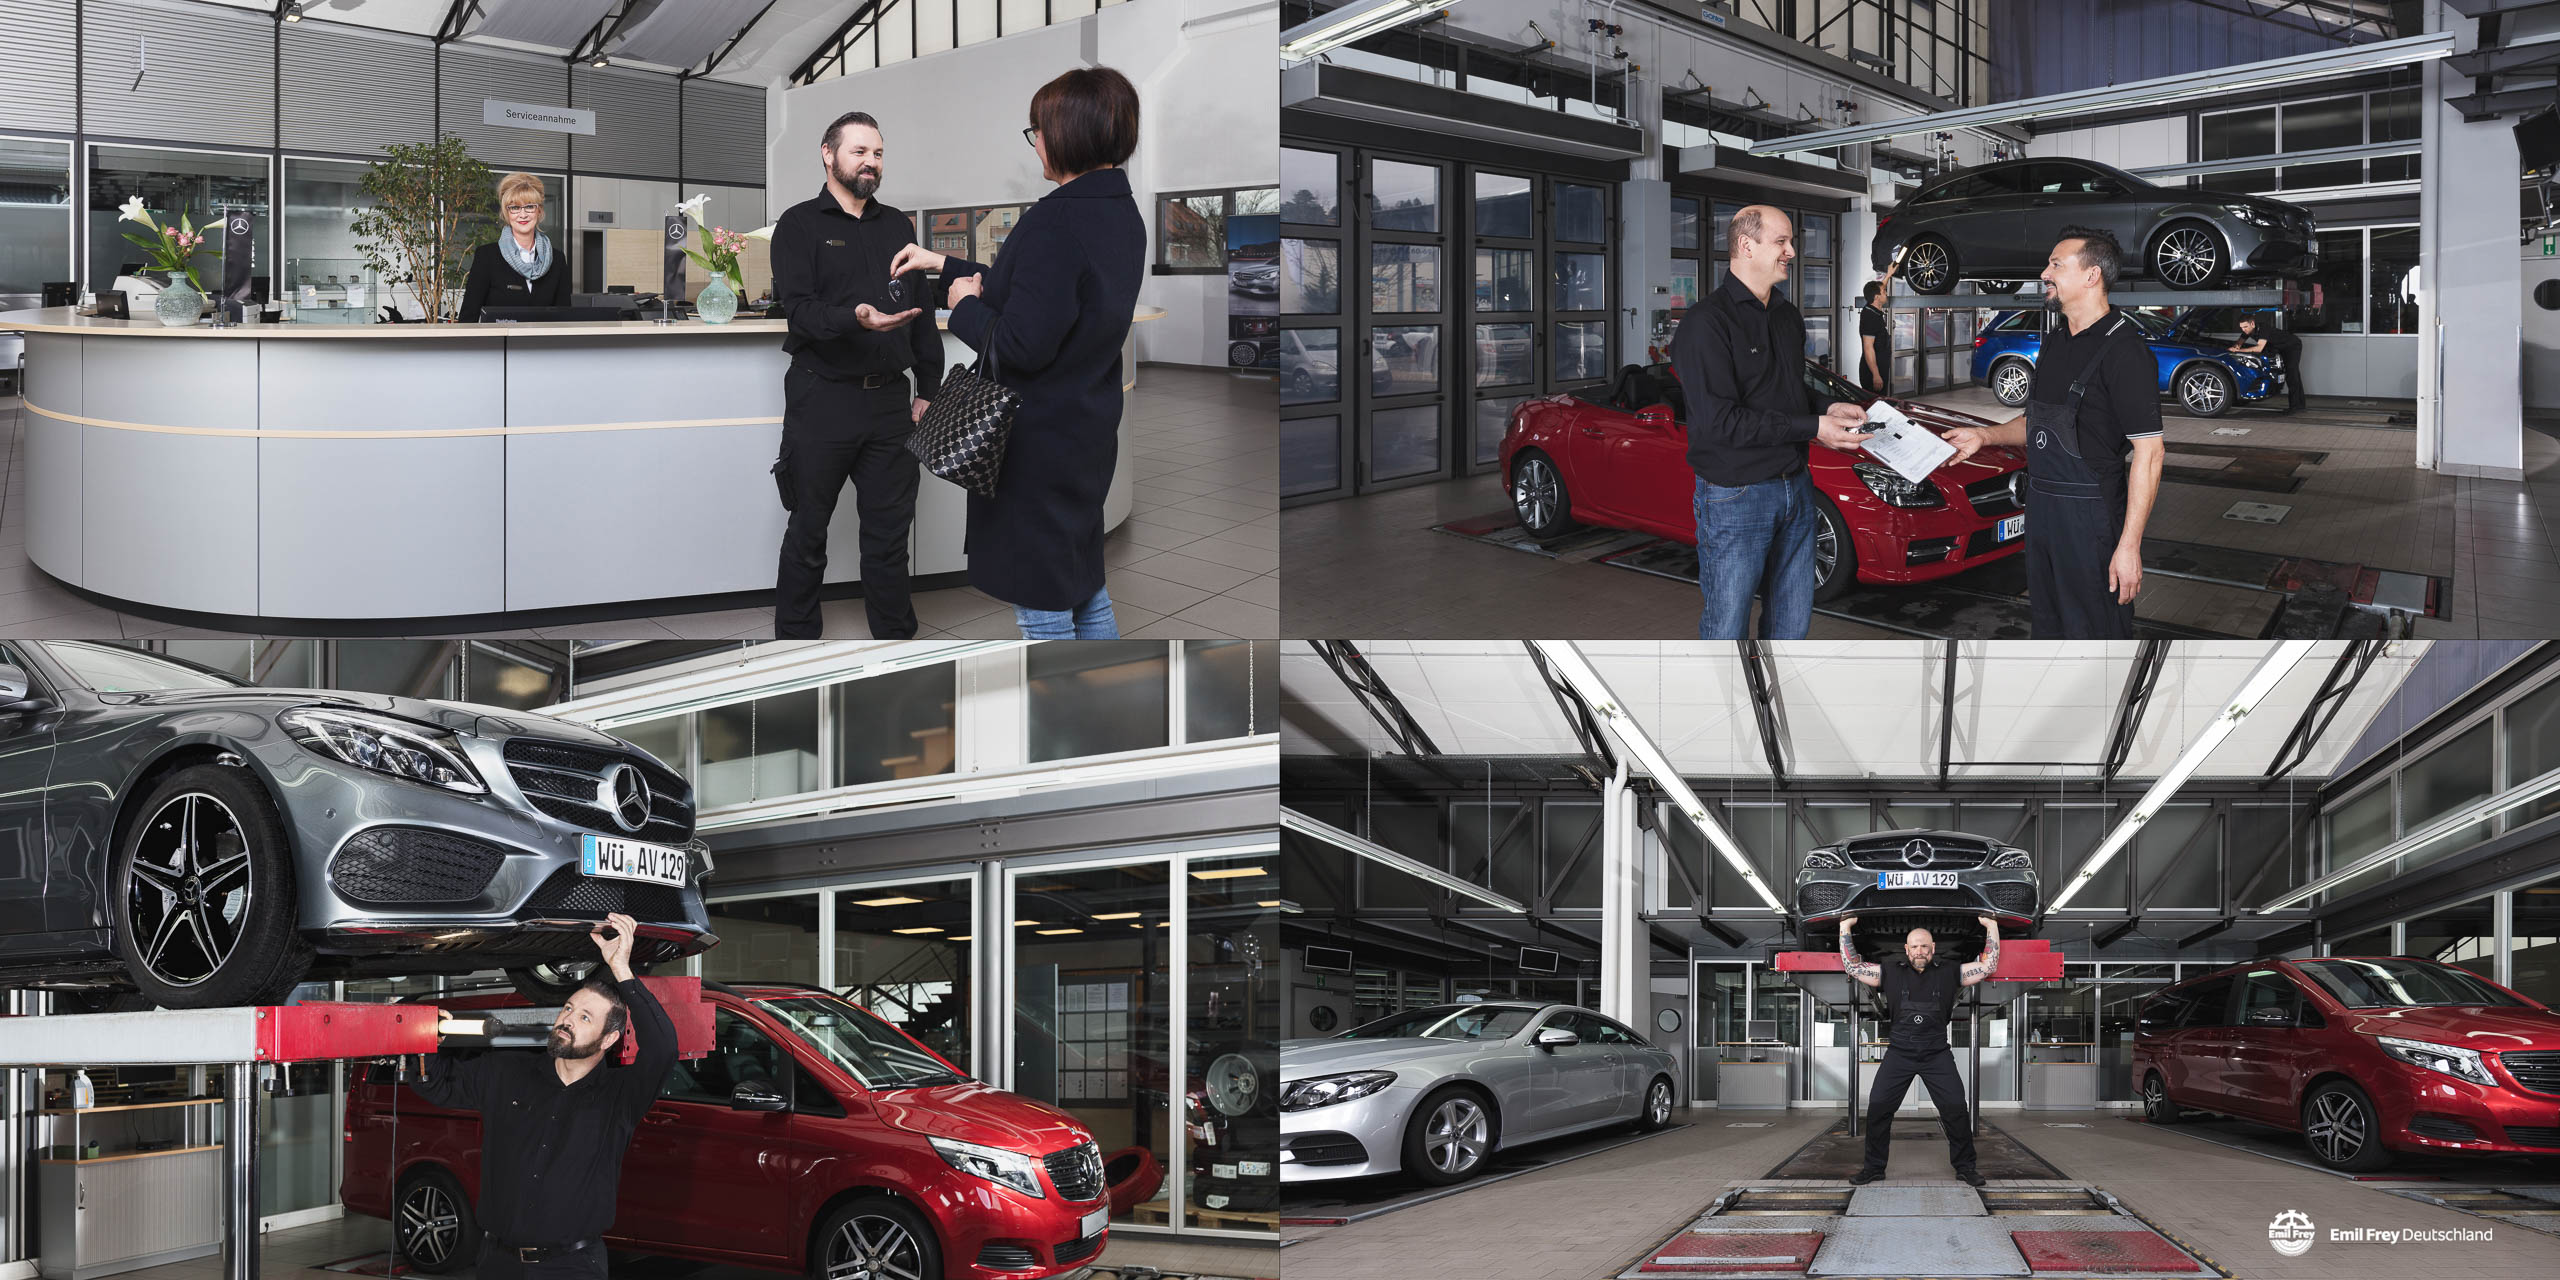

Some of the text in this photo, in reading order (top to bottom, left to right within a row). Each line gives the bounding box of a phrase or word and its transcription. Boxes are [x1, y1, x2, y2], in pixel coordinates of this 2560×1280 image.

[506, 109, 576, 124] Serviceannahme
[598, 842, 624, 872] WÜ
[637, 847, 657, 876] AV
[661, 852, 684, 881] 129
[1887, 873, 1903, 886] WÜ
[1912, 873, 1929, 886] AV
[1932, 873, 1956, 886] 129
